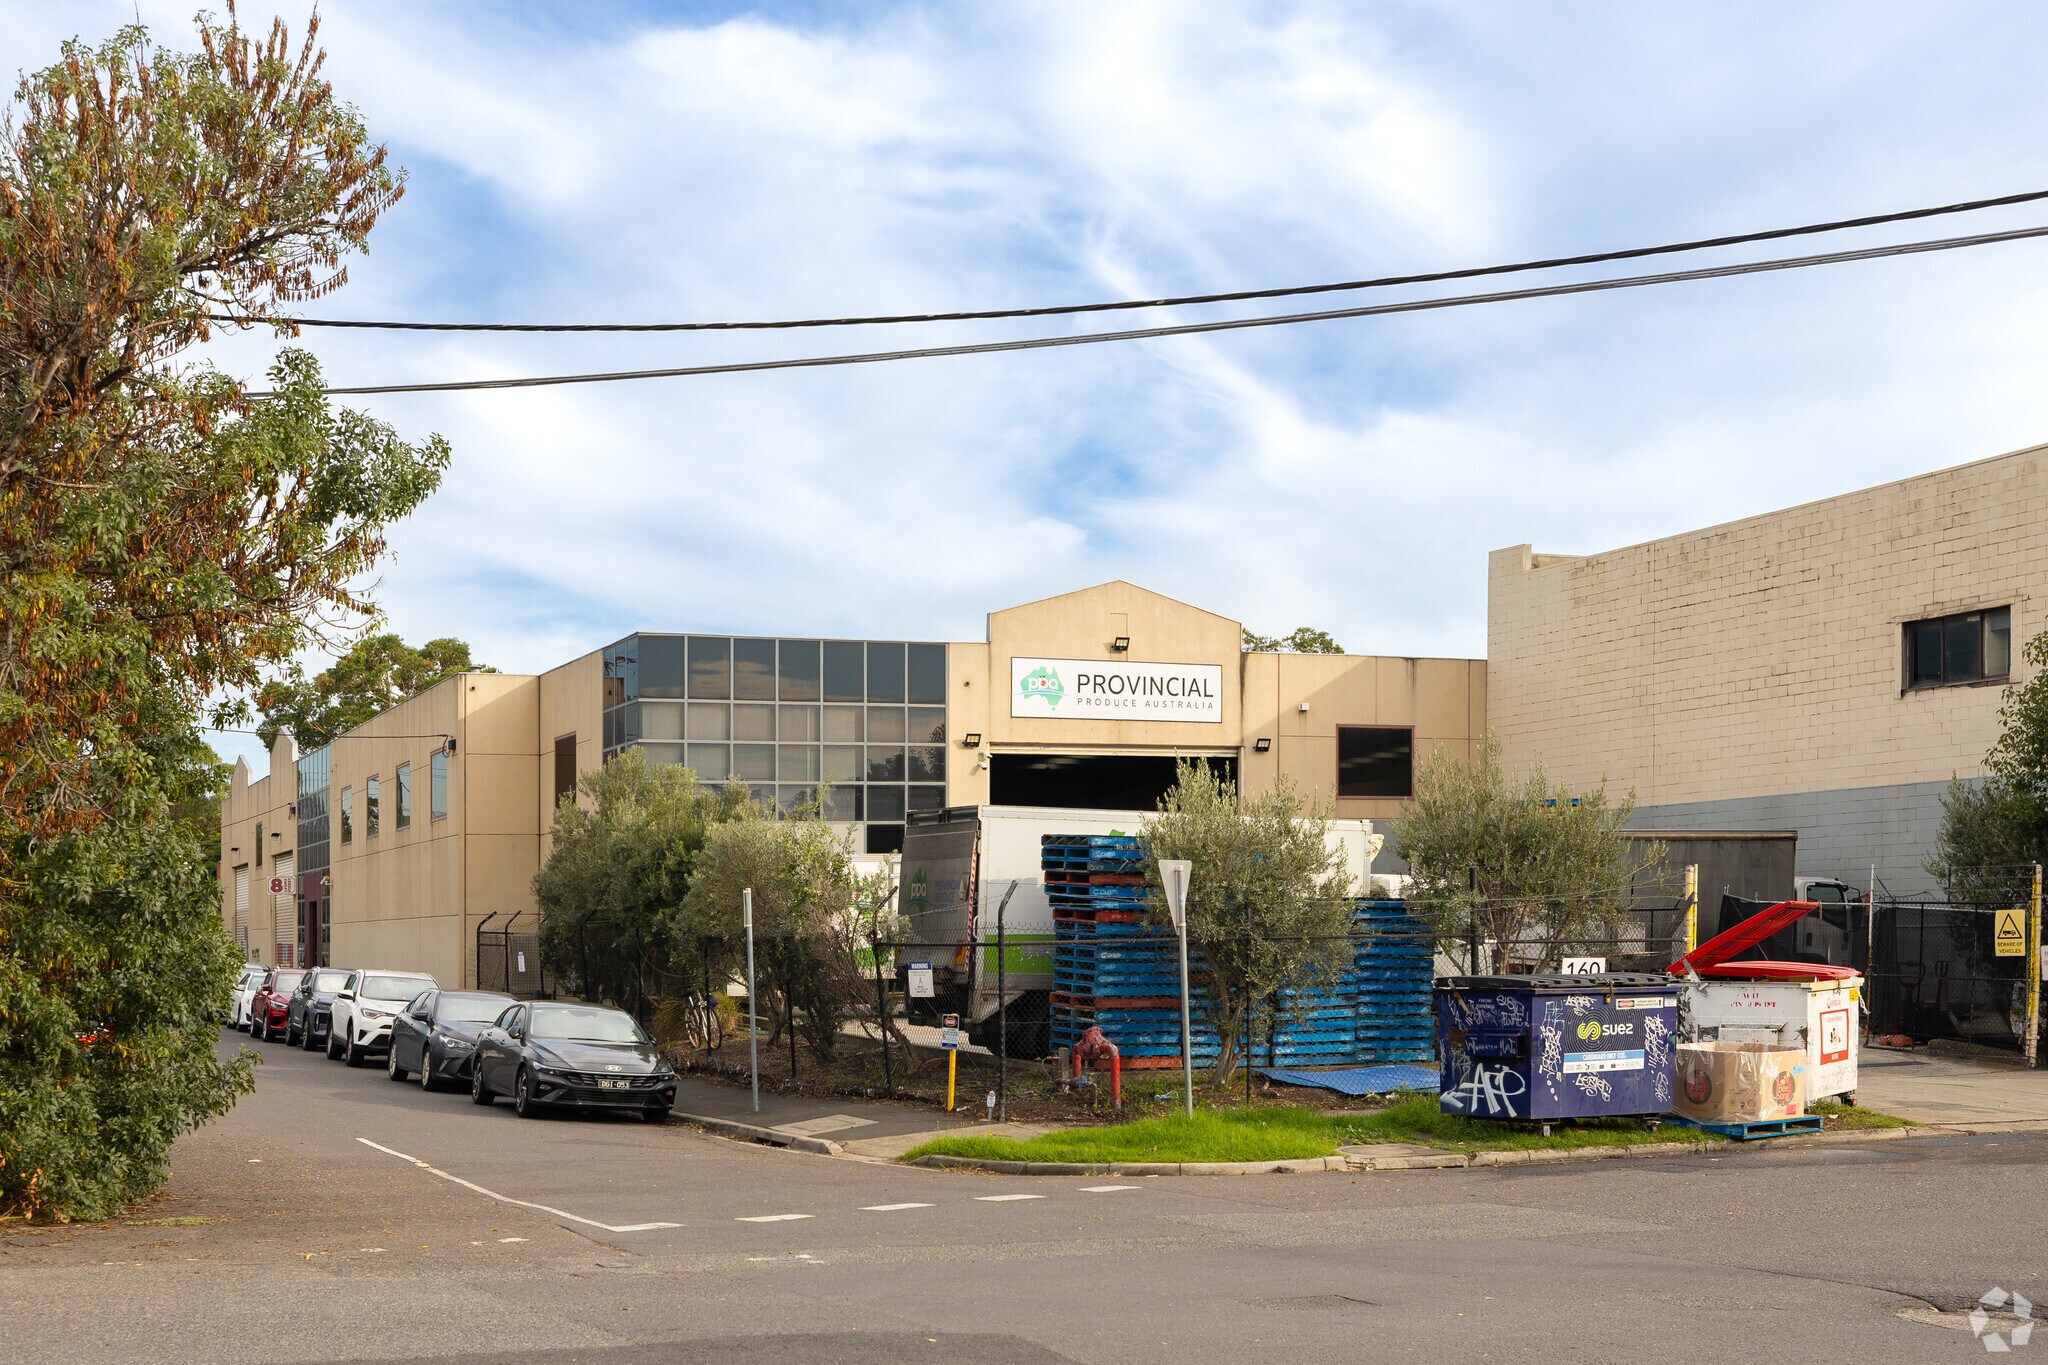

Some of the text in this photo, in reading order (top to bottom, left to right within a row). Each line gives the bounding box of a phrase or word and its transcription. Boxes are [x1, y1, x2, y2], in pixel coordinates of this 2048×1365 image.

[1028, 677, 1058, 690] ppa
[1077, 674, 1214, 698] PROVINCIAL
[1077, 697, 1214, 710] PRODUCE AUSTRALIA
[270, 878, 283, 893] 8
[1567, 961, 1600, 974] 160
[1602, 1023, 1634, 1036] suez
